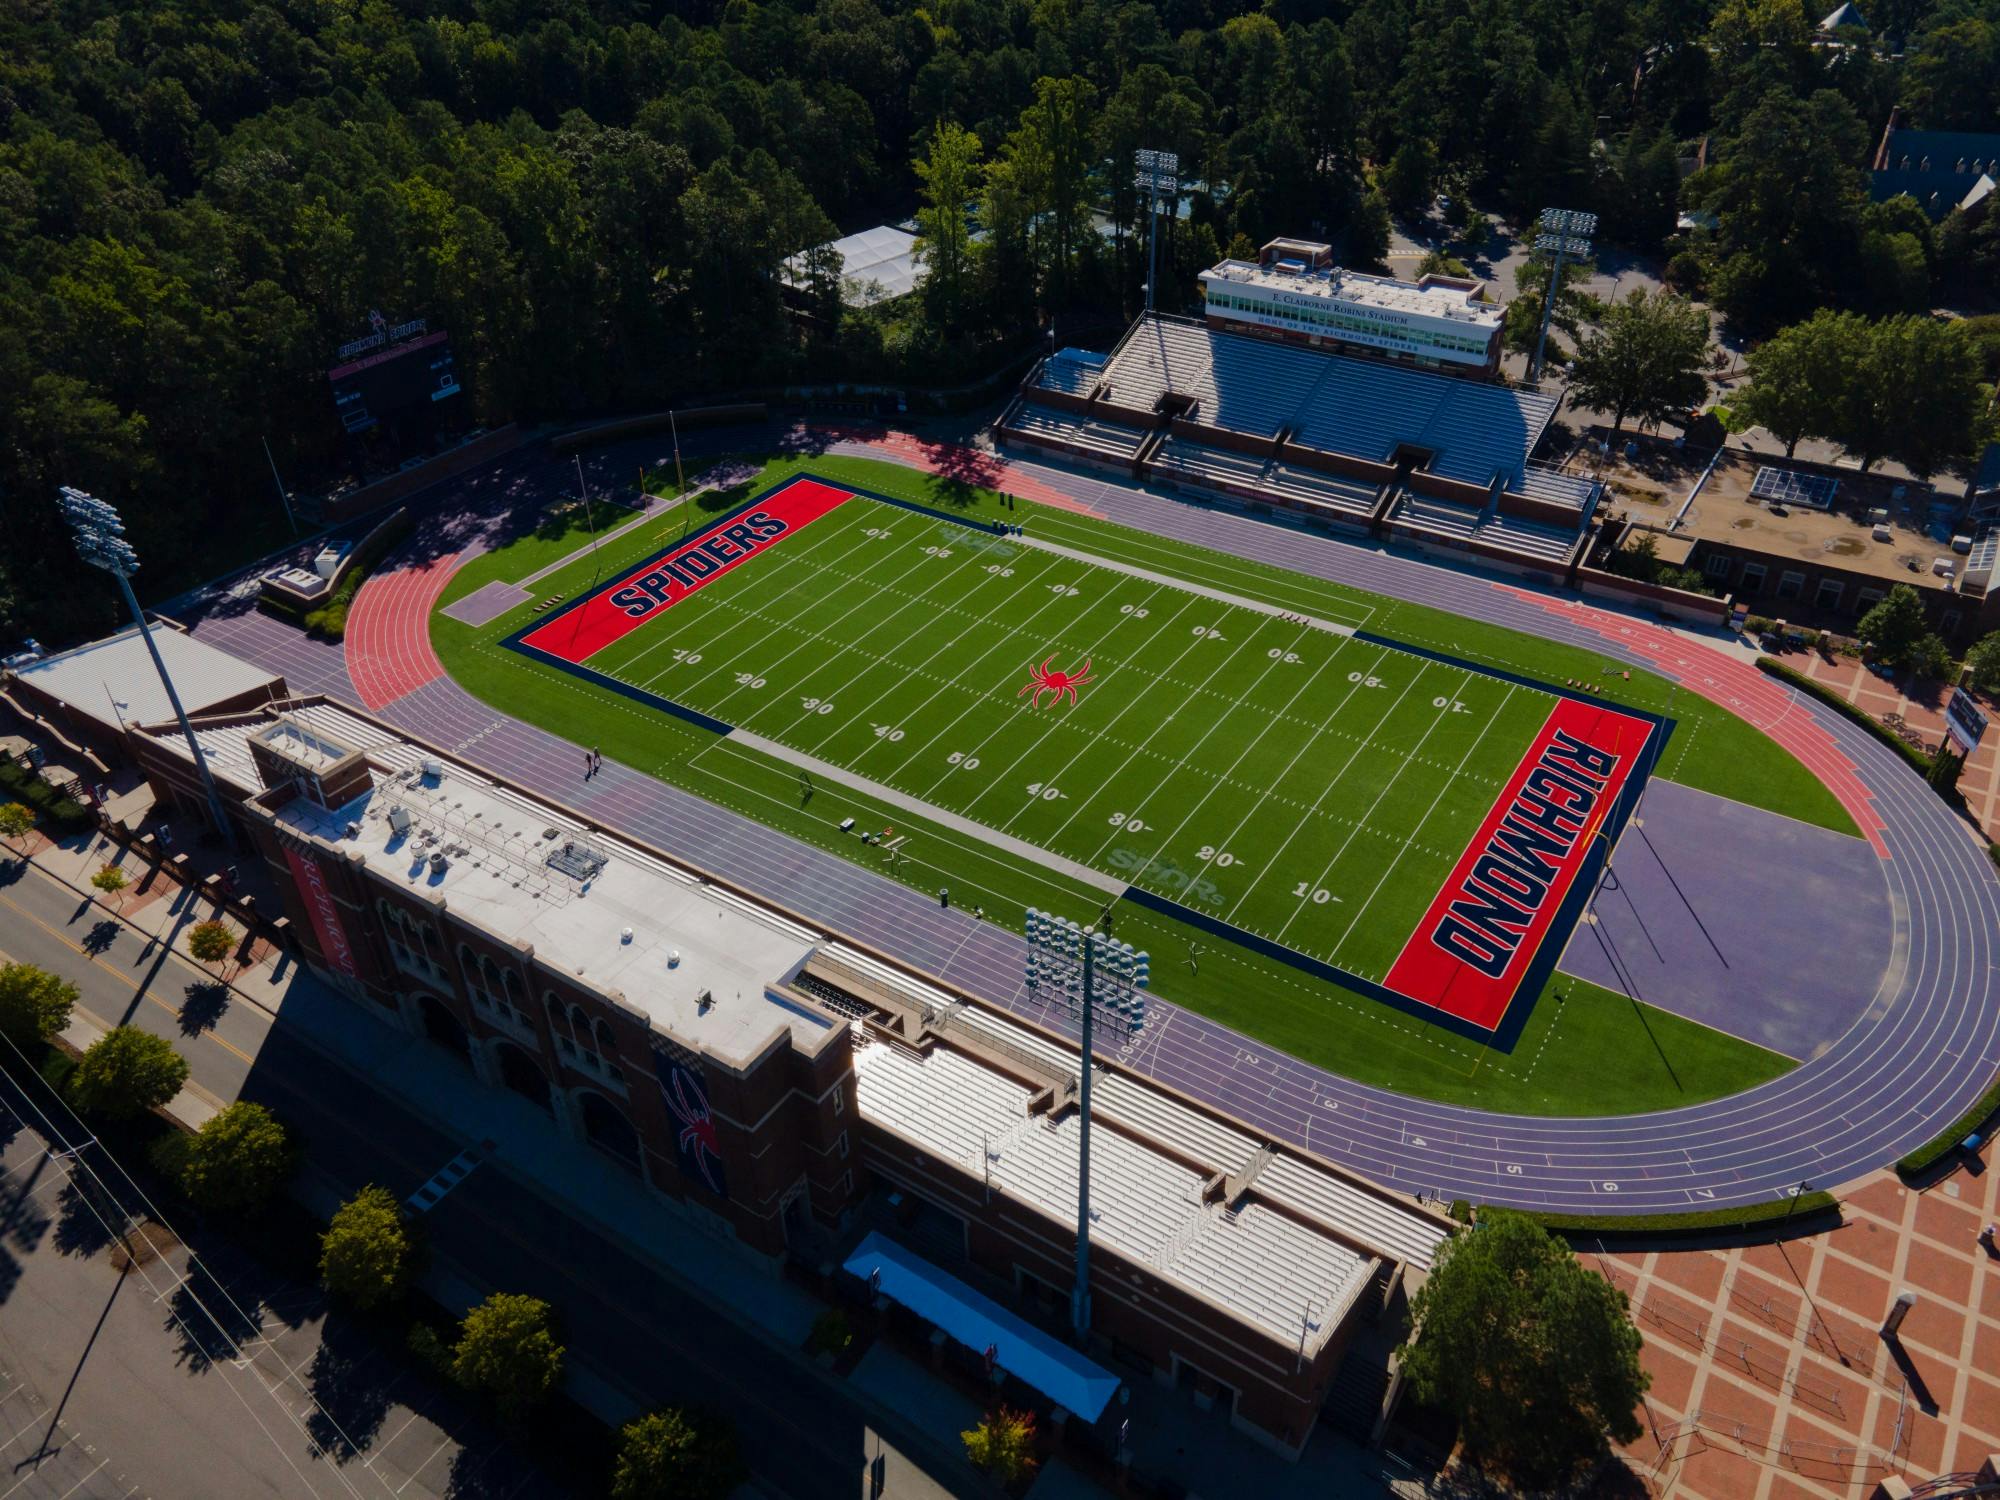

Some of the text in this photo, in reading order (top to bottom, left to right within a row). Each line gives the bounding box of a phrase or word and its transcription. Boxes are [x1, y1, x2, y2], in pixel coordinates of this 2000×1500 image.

[1283, 295, 1332, 312] CLAIBORNE
[1333, 304, 1367, 318] ROBINS
[1367, 310, 1408, 325] STADIUM
[1258, 316, 1283, 327] HOME
[1378, 338, 1419, 352] SPIDERS
[610, 512, 788, 617] SPIDERS
[866, 527, 1466, 714] 10 20 30 40 50 40 30 20 10
[675, 648, 1332, 905] 10 20 30 40 50 40 30 20 10
[1432, 727, 1621, 979] RICHMOND
[300, 855, 356, 977] RICHMOND
[1245, 1053, 1260, 1065] 2
[1324, 1099, 1338, 1110] 3
[1412, 1136, 1428, 1148] 4
[1506, 1164, 1523, 1176] 5
[1602, 1181, 1619, 1193] 6
[1697, 1188, 1715, 1199] 7
